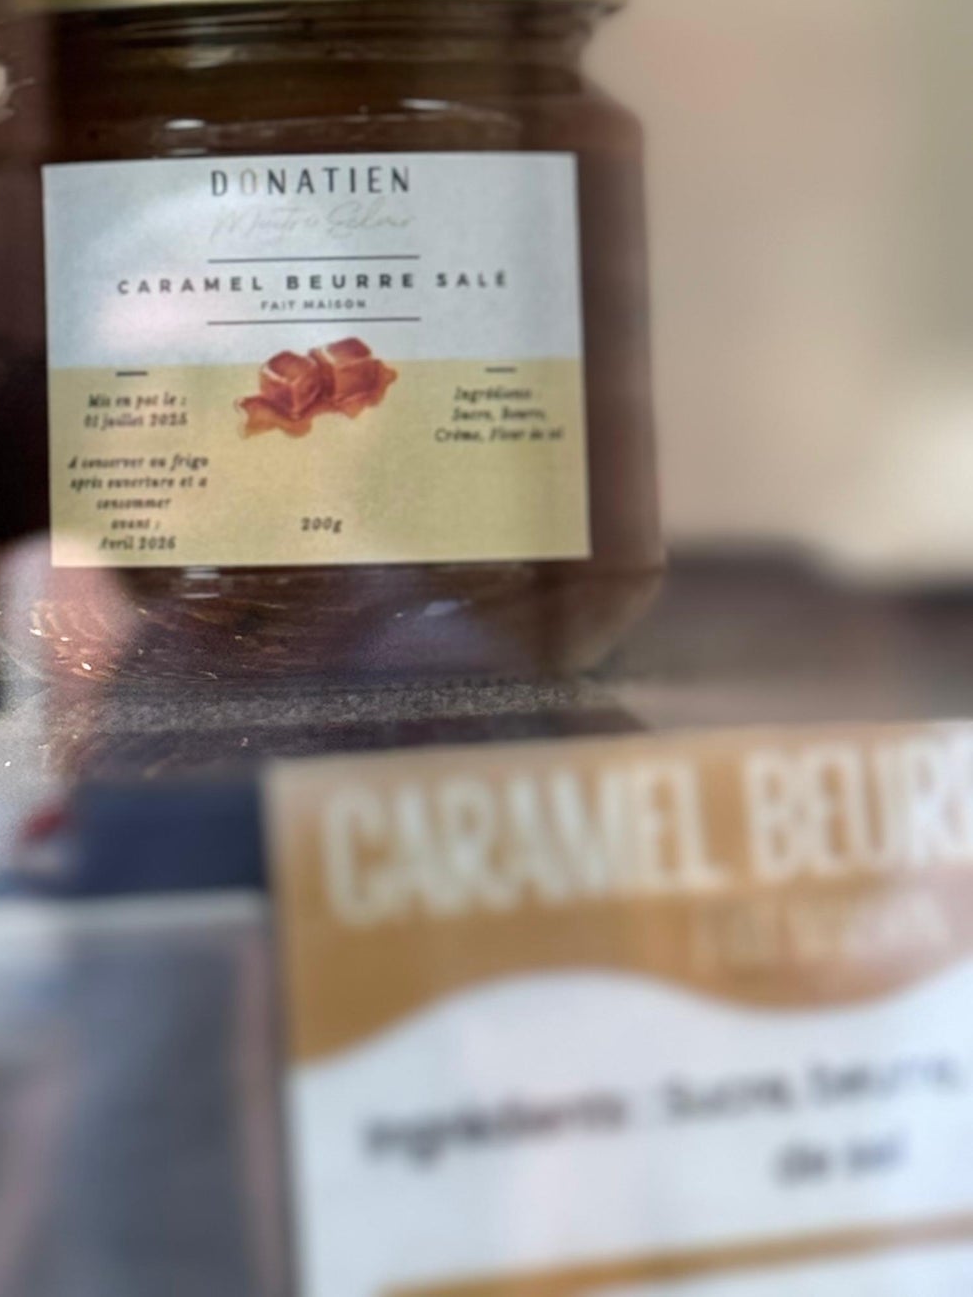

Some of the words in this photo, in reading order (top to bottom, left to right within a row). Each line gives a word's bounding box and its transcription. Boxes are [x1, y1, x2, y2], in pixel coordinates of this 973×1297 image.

[210, 166, 410, 197] DONATIEN
[117, 275, 264, 295] CARAMEL
[285, 272, 415, 291] BEURRE
[435, 269, 509, 289] SALÉ
[260, 299, 296, 311] FAIT
[302, 298, 368, 311] MAISON
[170, 452, 209, 471] frigo
[300, 515, 343, 535] 200g
[321, 758, 724, 926] CARAMEL
